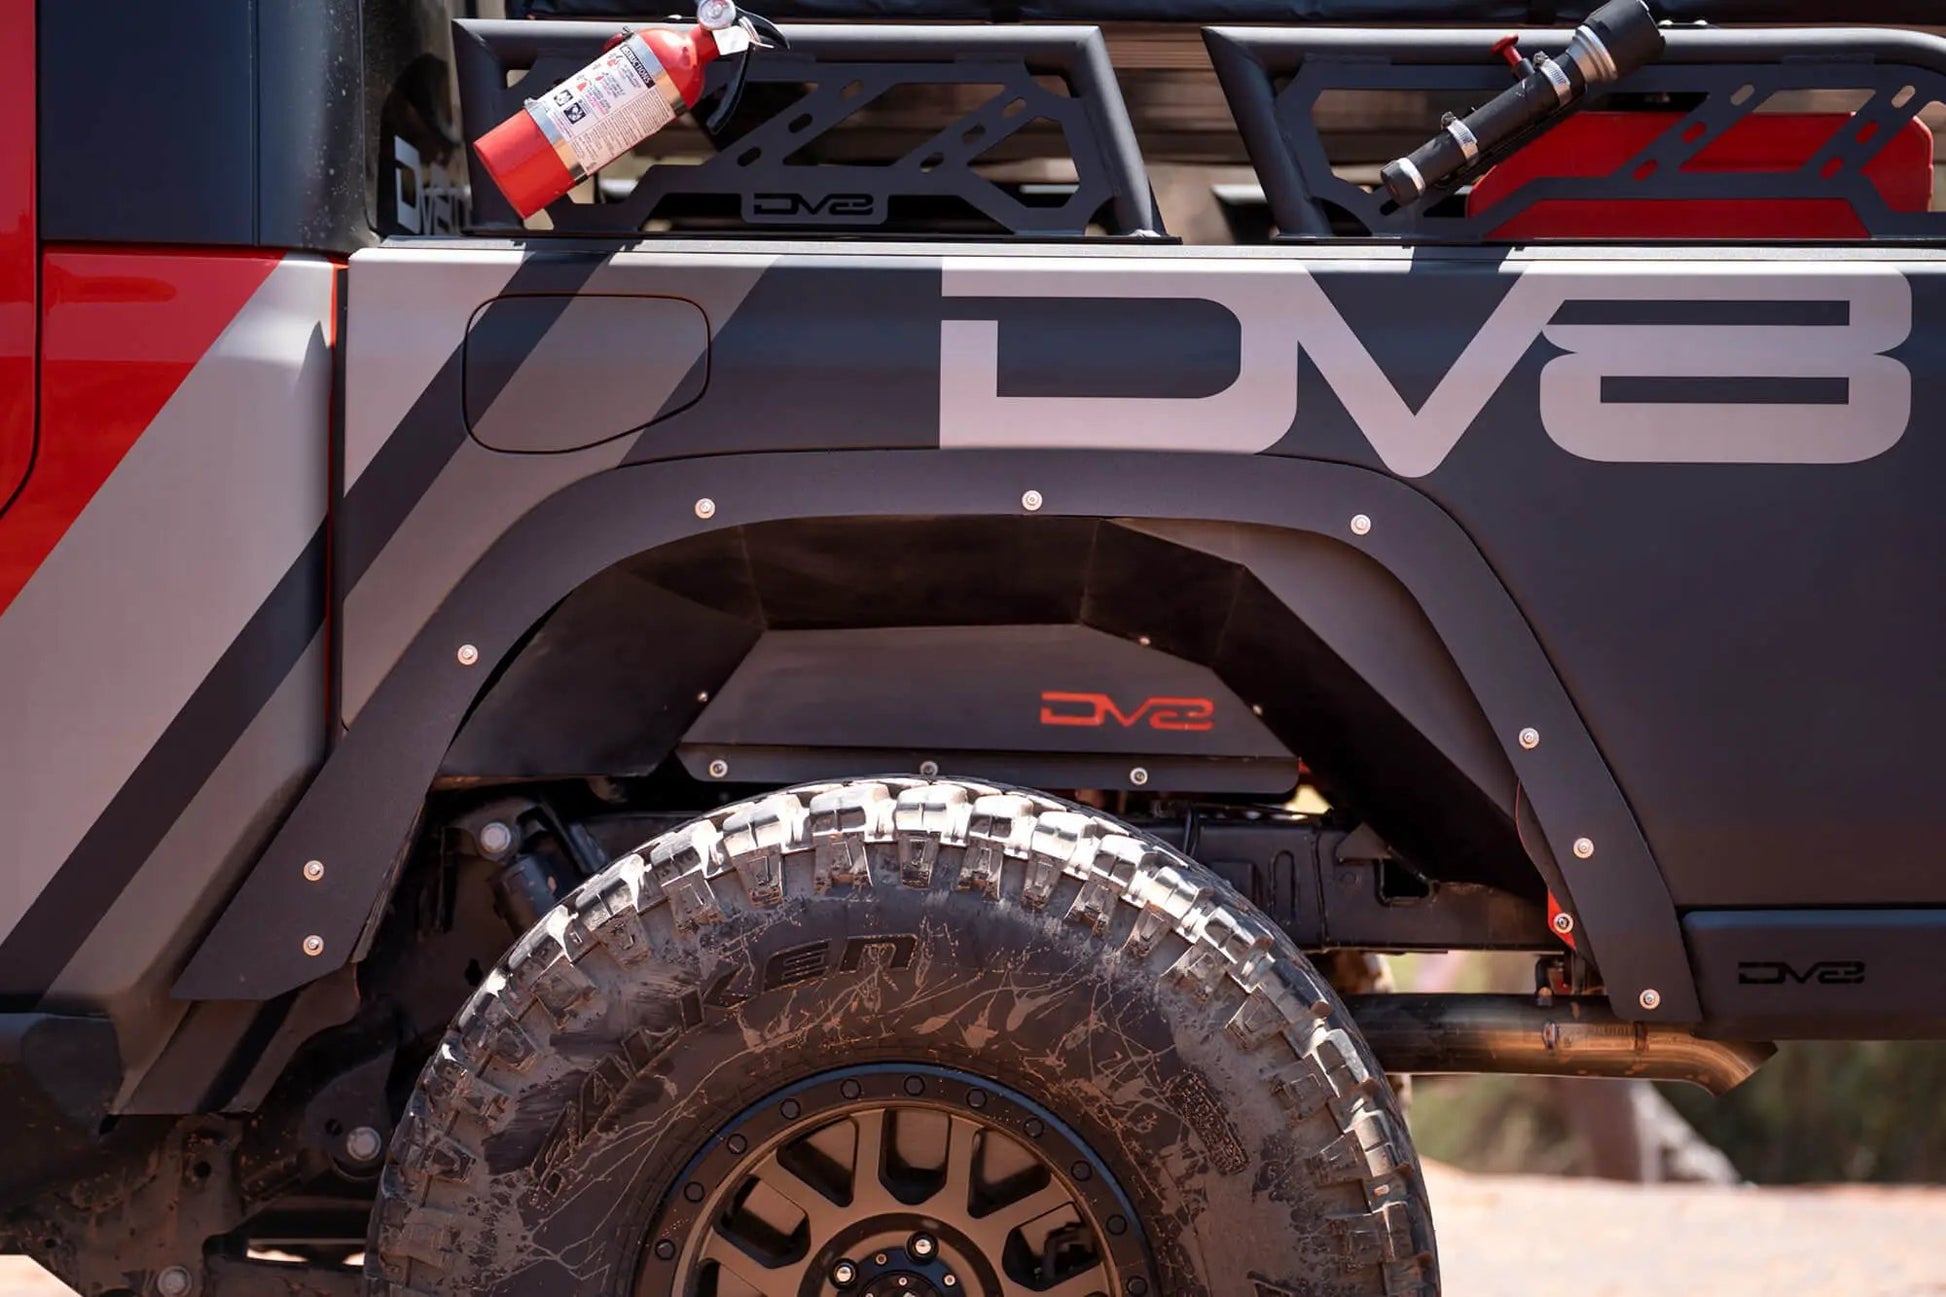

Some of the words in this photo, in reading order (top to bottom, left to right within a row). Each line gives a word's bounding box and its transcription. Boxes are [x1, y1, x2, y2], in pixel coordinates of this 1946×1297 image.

[753, 193, 874, 215] DV8
[940, 257, 1912, 478] DV8
[1040, 691, 1214, 731] DV8
[1738, 961, 1865, 984] DV8
